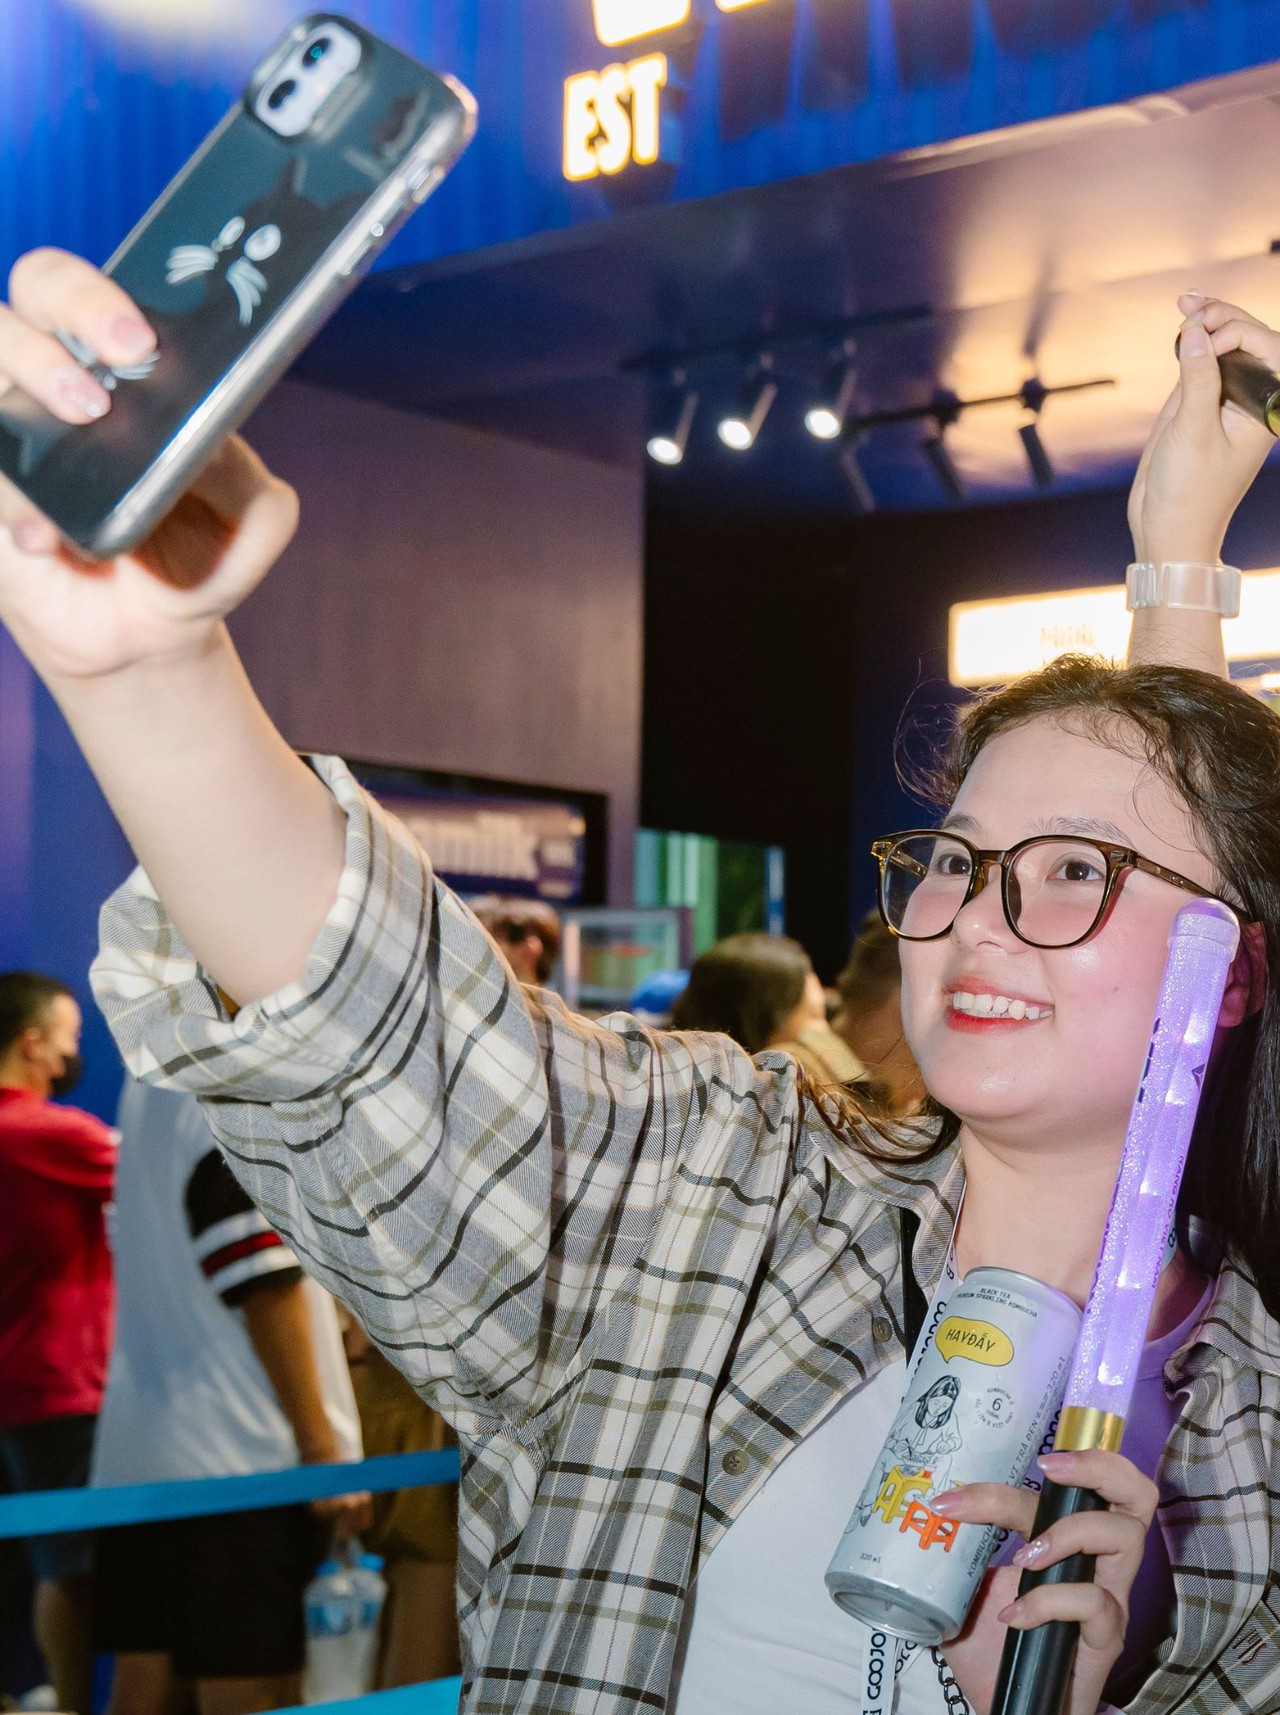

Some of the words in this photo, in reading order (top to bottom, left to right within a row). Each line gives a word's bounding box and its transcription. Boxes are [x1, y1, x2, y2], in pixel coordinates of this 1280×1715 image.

[563, 52, 667, 181] EST
[1000, 1290, 1011, 1300] TEA
[1046, 1370, 1059, 1392] 320
[992, 1397, 1003, 1412] 6
